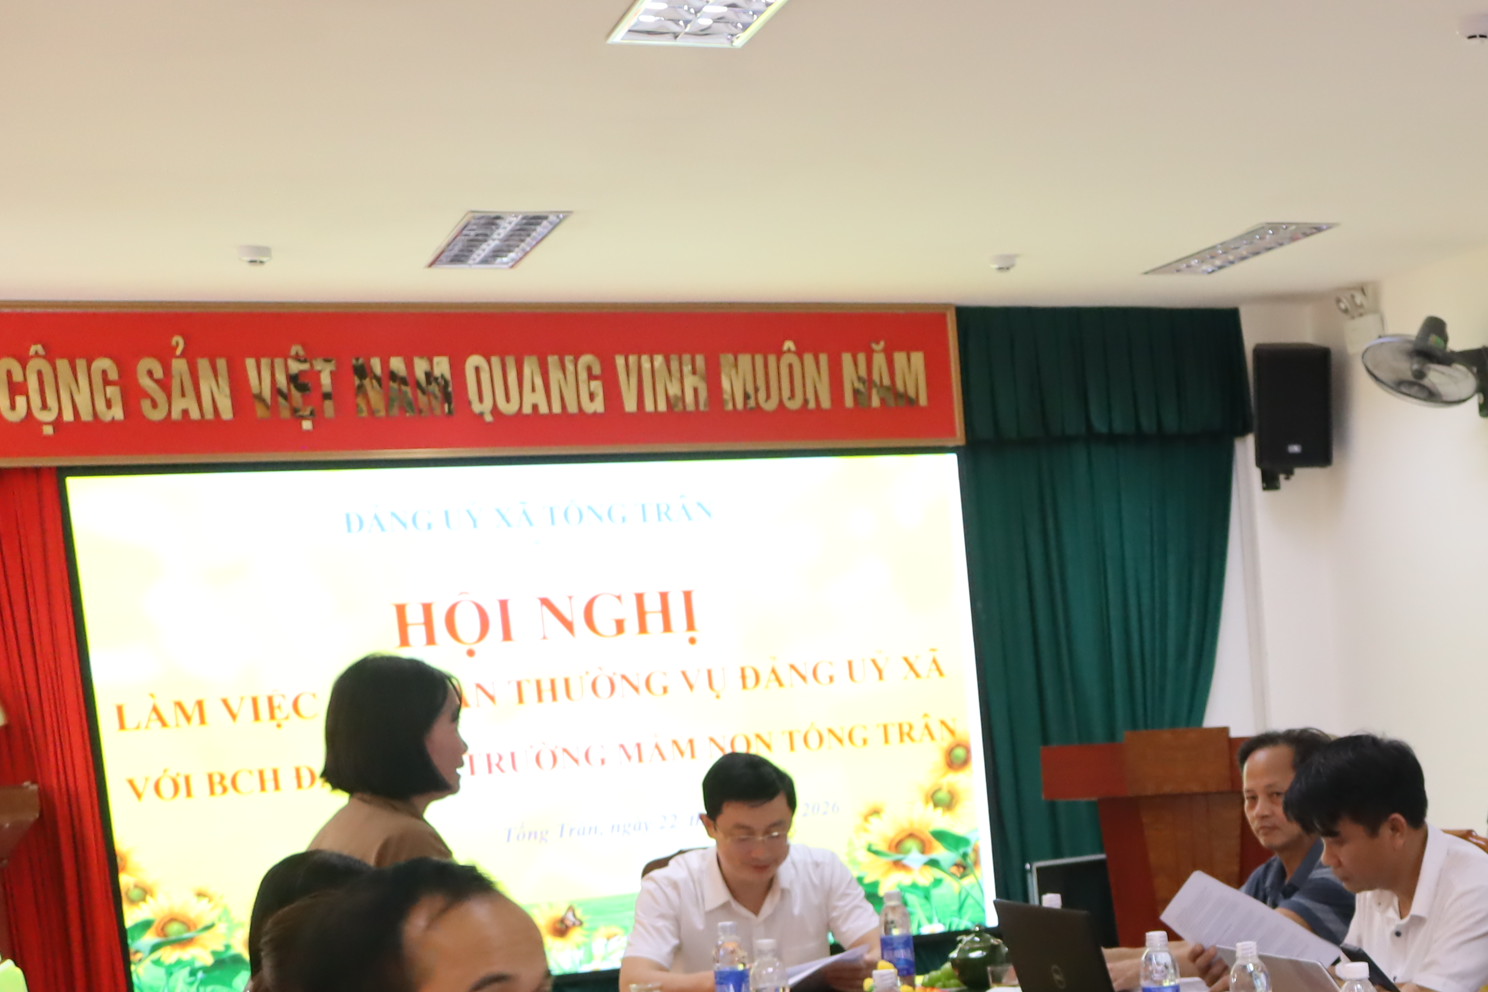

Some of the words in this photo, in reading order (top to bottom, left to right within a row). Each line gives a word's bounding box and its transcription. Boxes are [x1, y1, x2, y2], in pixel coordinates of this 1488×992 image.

[0, 344, 125, 435] CỘNG
[137, 335, 234, 421] SẢN
[245, 344, 337, 430] VIỆT
[352, 355, 455, 417] NAM
[465, 353, 605, 422] QUANG
[614, 353, 710, 413] VINH
[719, 339, 832, 411] MUÔN
[842, 340, 928, 408] NĂM
[494, 501, 535, 529] XÃ
[391, 591, 518, 658] HỘI
[536, 589, 699, 646] NGHỊ
[113, 692, 210, 732] LÀM
[220, 689, 319, 730] VIỆC
[508, 666, 669, 705] THƯỜNG
[681, 666, 727, 700] VỤ
[739, 656, 836, 691] ĐẢNG
[902, 648, 947, 681] XÃ
[126, 768, 195, 802] VỚI
[206, 767, 282, 797] BCH
[466, 741, 606, 776] TRƯỜNG
[708, 730, 775, 755] NON
[781, 721, 869, 753] TỐNG
[876, 712, 958, 746] TRÂN
